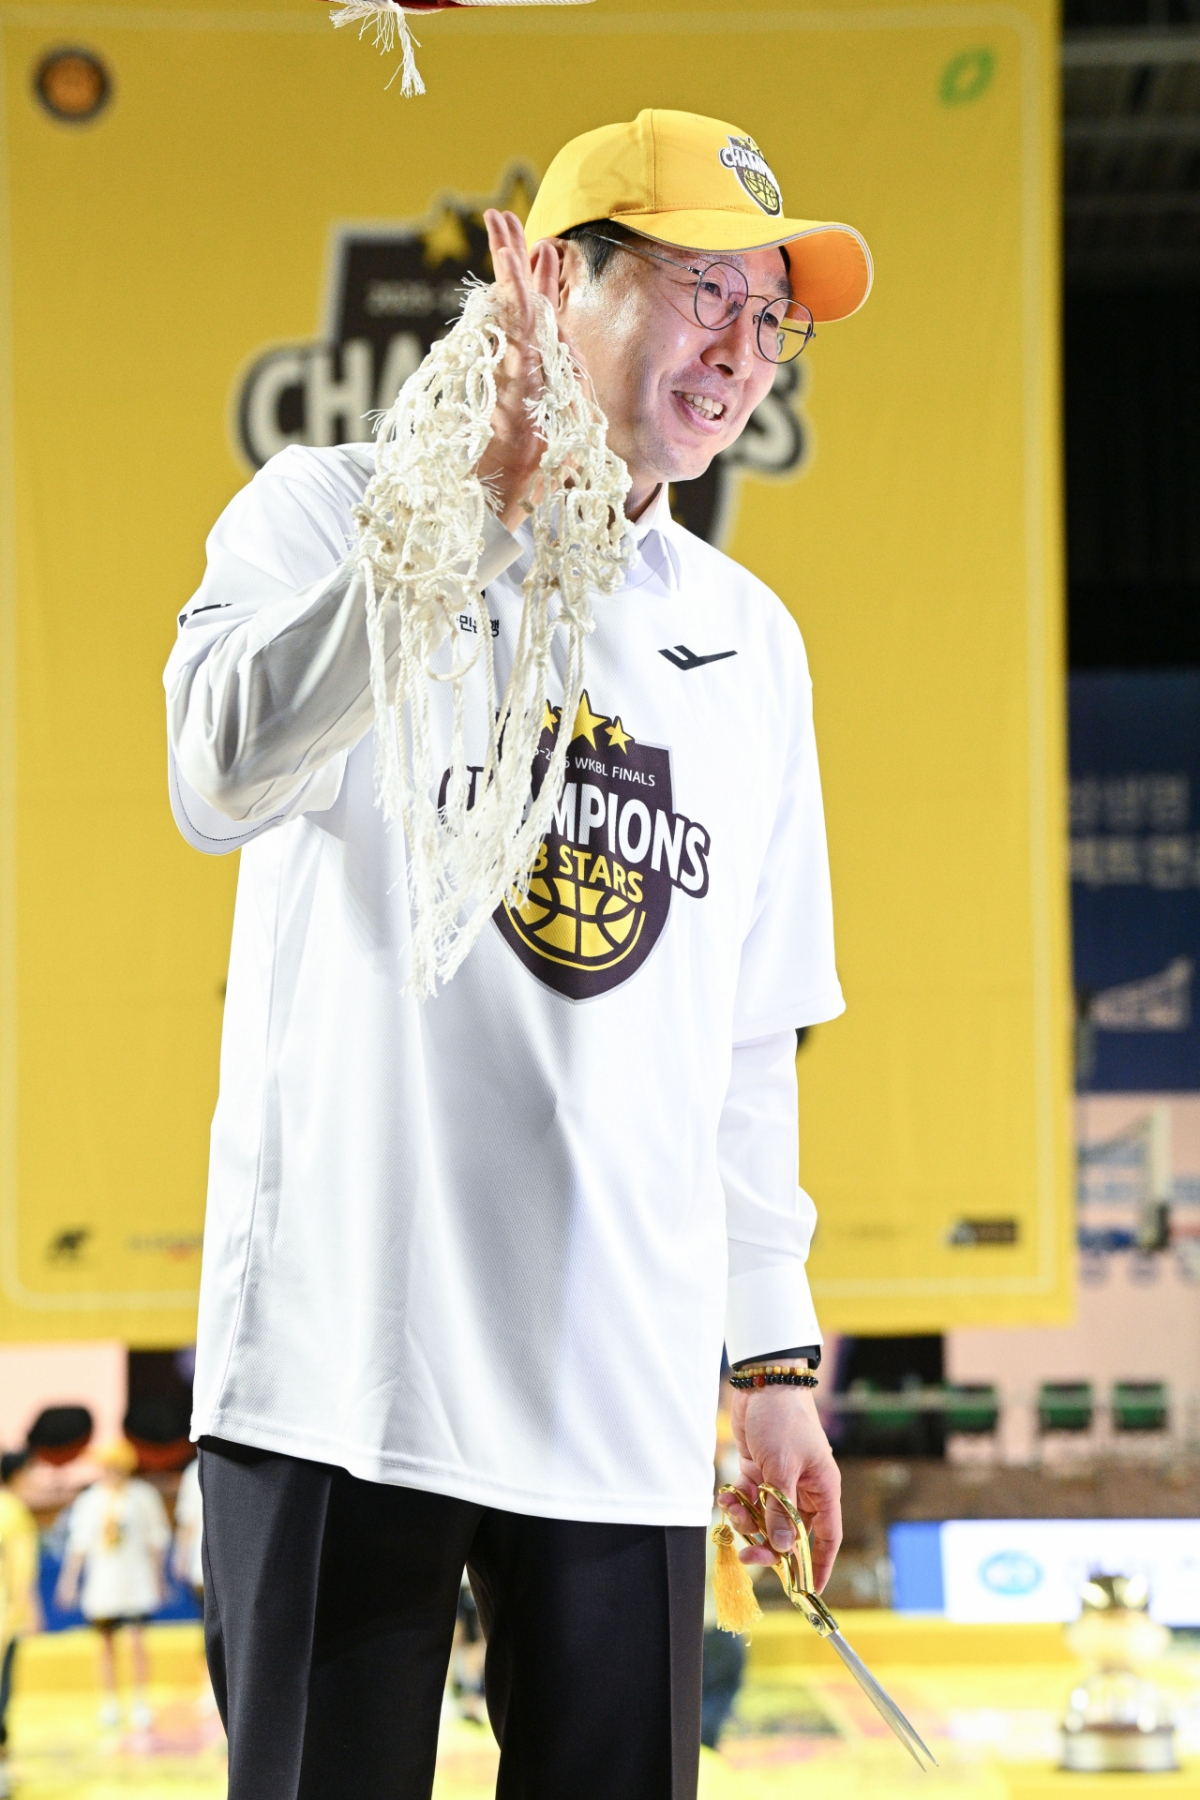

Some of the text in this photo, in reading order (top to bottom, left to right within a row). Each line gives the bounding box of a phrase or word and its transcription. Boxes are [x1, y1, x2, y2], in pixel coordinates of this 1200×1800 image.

[574, 756, 608, 777] WKBL
[612, 766, 656, 787] FINALS
[558, 844, 644, 904] STARS
